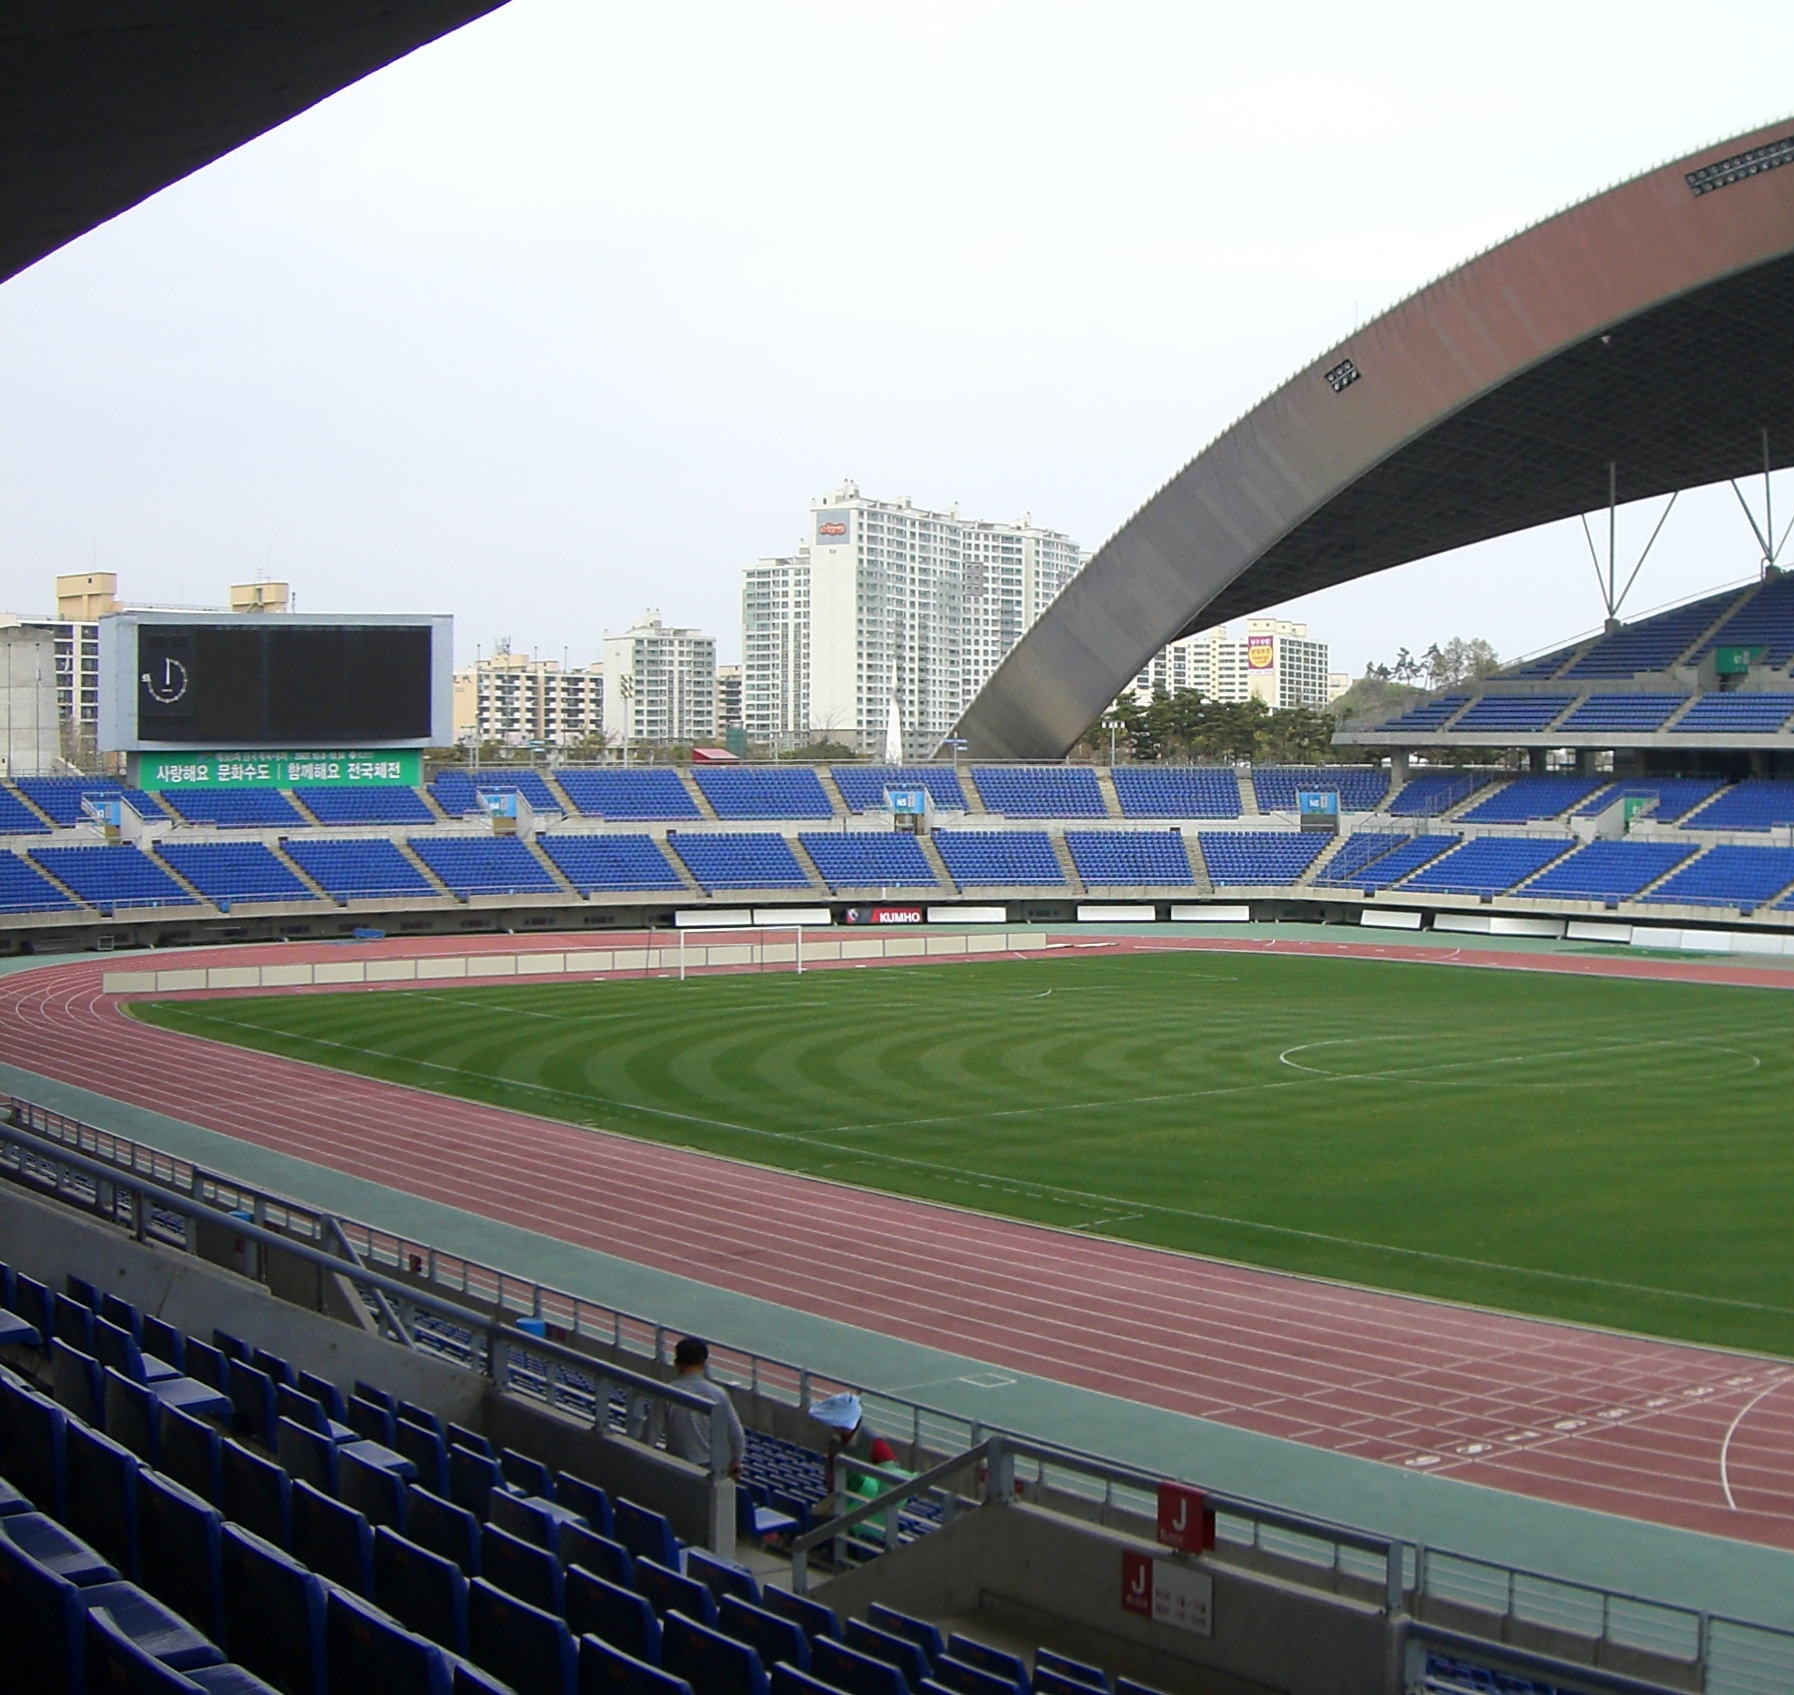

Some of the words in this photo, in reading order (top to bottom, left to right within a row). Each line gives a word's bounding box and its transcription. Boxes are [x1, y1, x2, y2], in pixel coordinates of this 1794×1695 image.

[156, 764, 209, 782] 사랑해요
[217, 763, 271, 781] 문화수도
[287, 762, 340, 780] 함께해요
[347, 761, 401, 779] 전국체전
[879, 912, 921, 923] KUMHO
[1172, 1498, 1187, 1532] J
[1131, 1565, 1146, 1595] J
